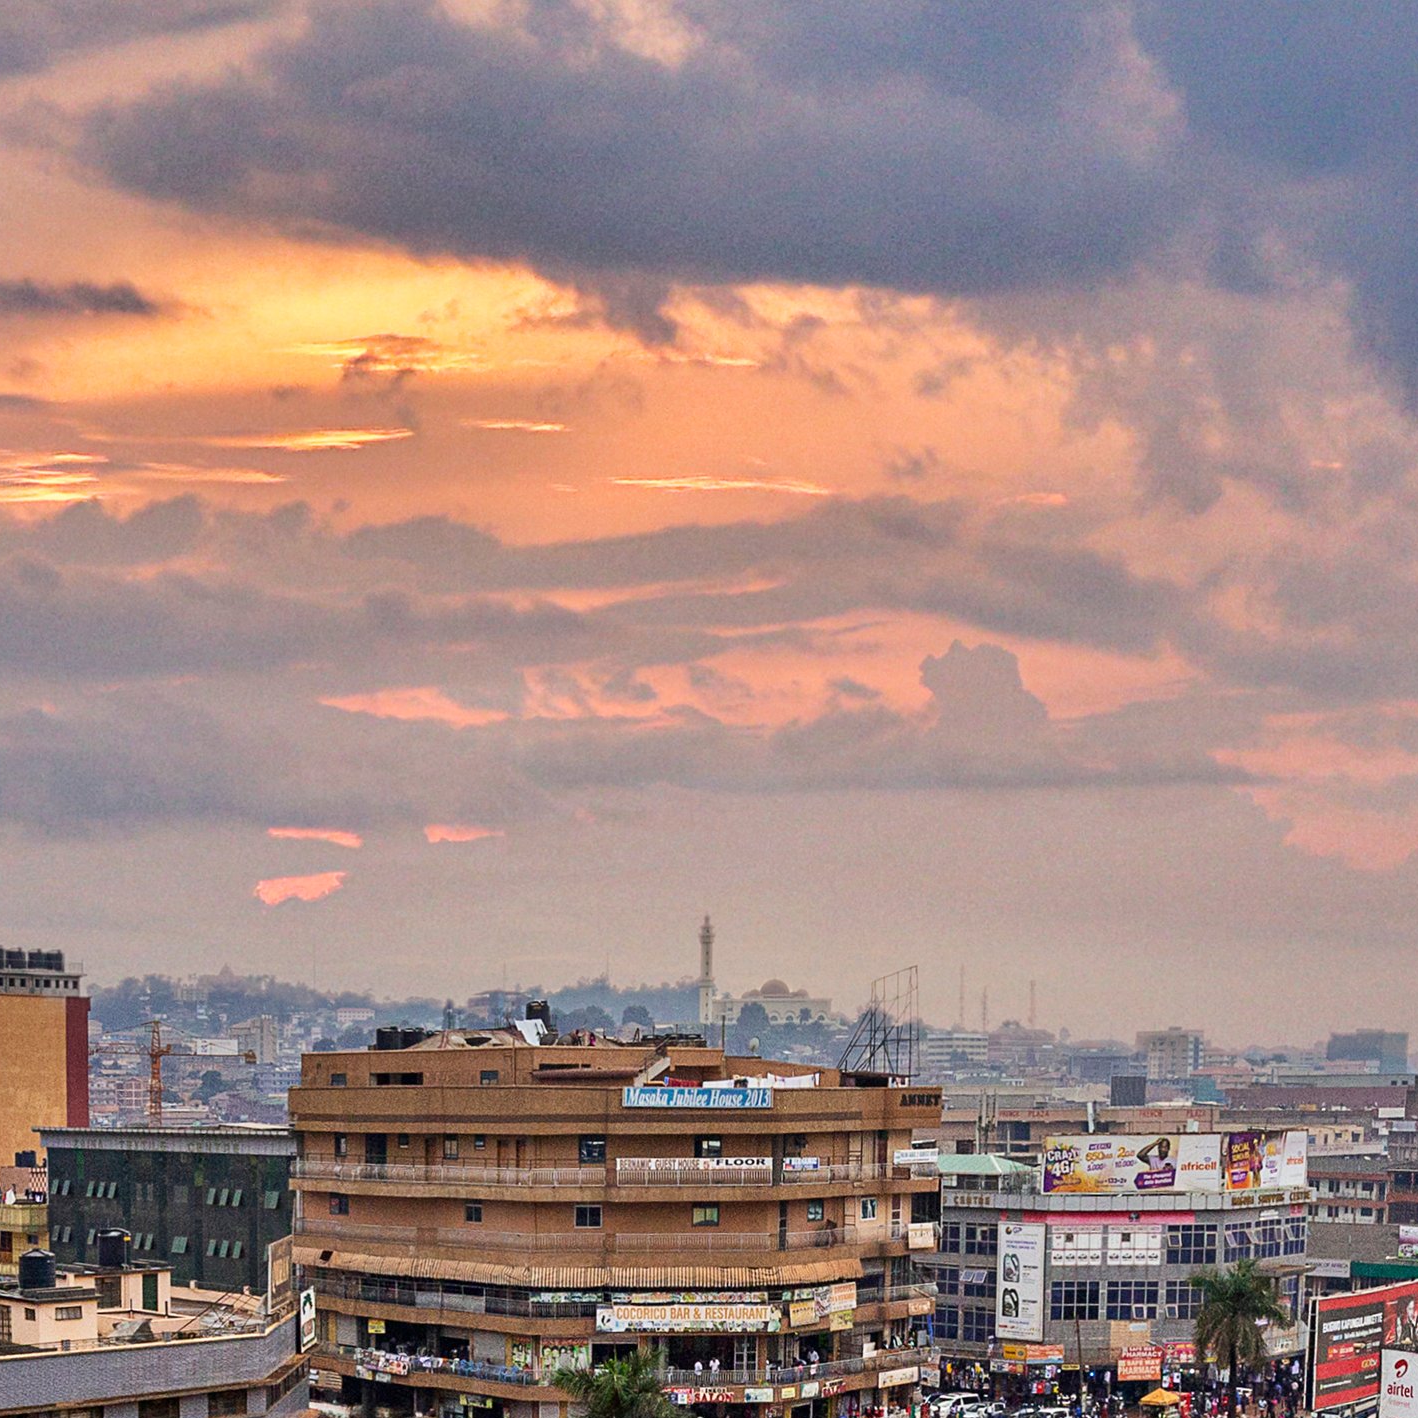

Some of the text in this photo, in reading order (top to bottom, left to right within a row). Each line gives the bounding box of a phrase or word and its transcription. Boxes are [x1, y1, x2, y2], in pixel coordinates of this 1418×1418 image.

[628, 1088, 771, 1107] Masaka Jubilee House 2013
[654, 1158, 766, 1170] GUEST HOUSE FLOOR
[1051, 1160, 1074, 1177] 4G!
[1180, 1159, 1217, 1171] africell
[616, 1306, 768, 1321] COCORICO BAR & RESTAURANT
[1118, 1366, 1161, 1375] PHARMACY
[693, 1391, 734, 1402] SALON
[1387, 1382, 1414, 1399] airtel
